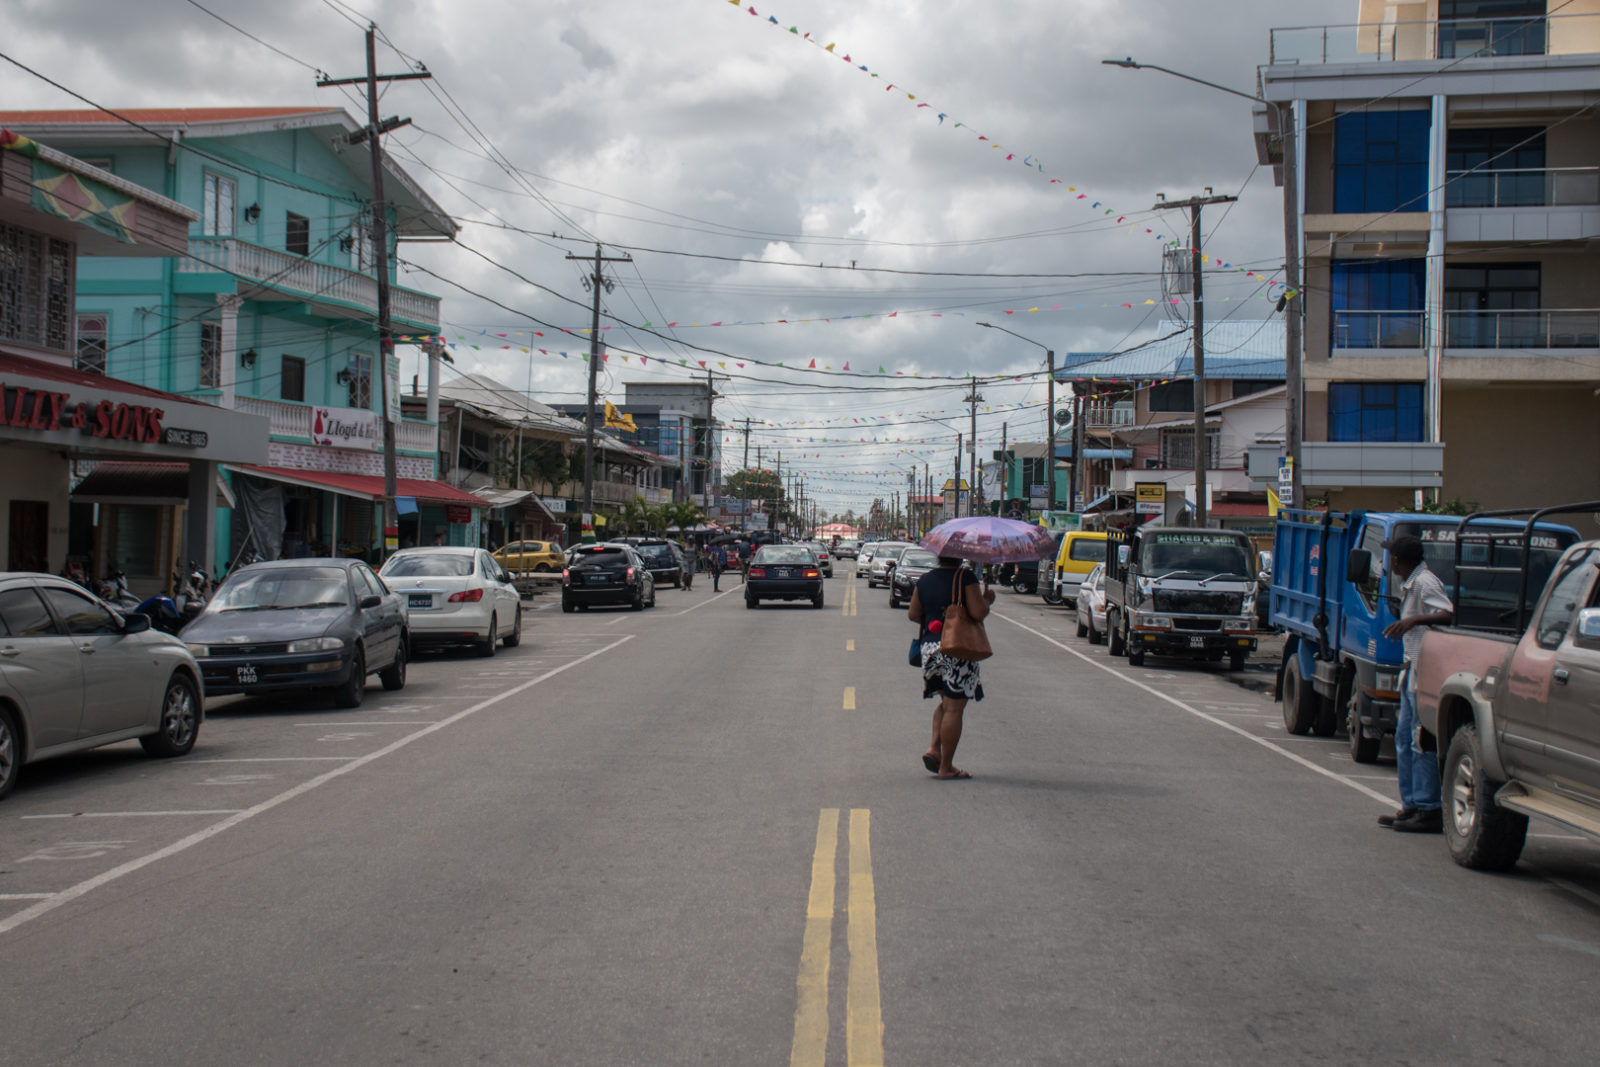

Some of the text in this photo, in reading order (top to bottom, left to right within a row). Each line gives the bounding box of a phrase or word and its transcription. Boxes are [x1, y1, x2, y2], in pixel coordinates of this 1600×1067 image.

[72, 403, 87, 429] &
[92, 399, 165, 444] SONS
[326, 418, 358, 440] Lloyd
[167, 429, 190, 445] SINCE
[237, 666, 256, 675] PKK
